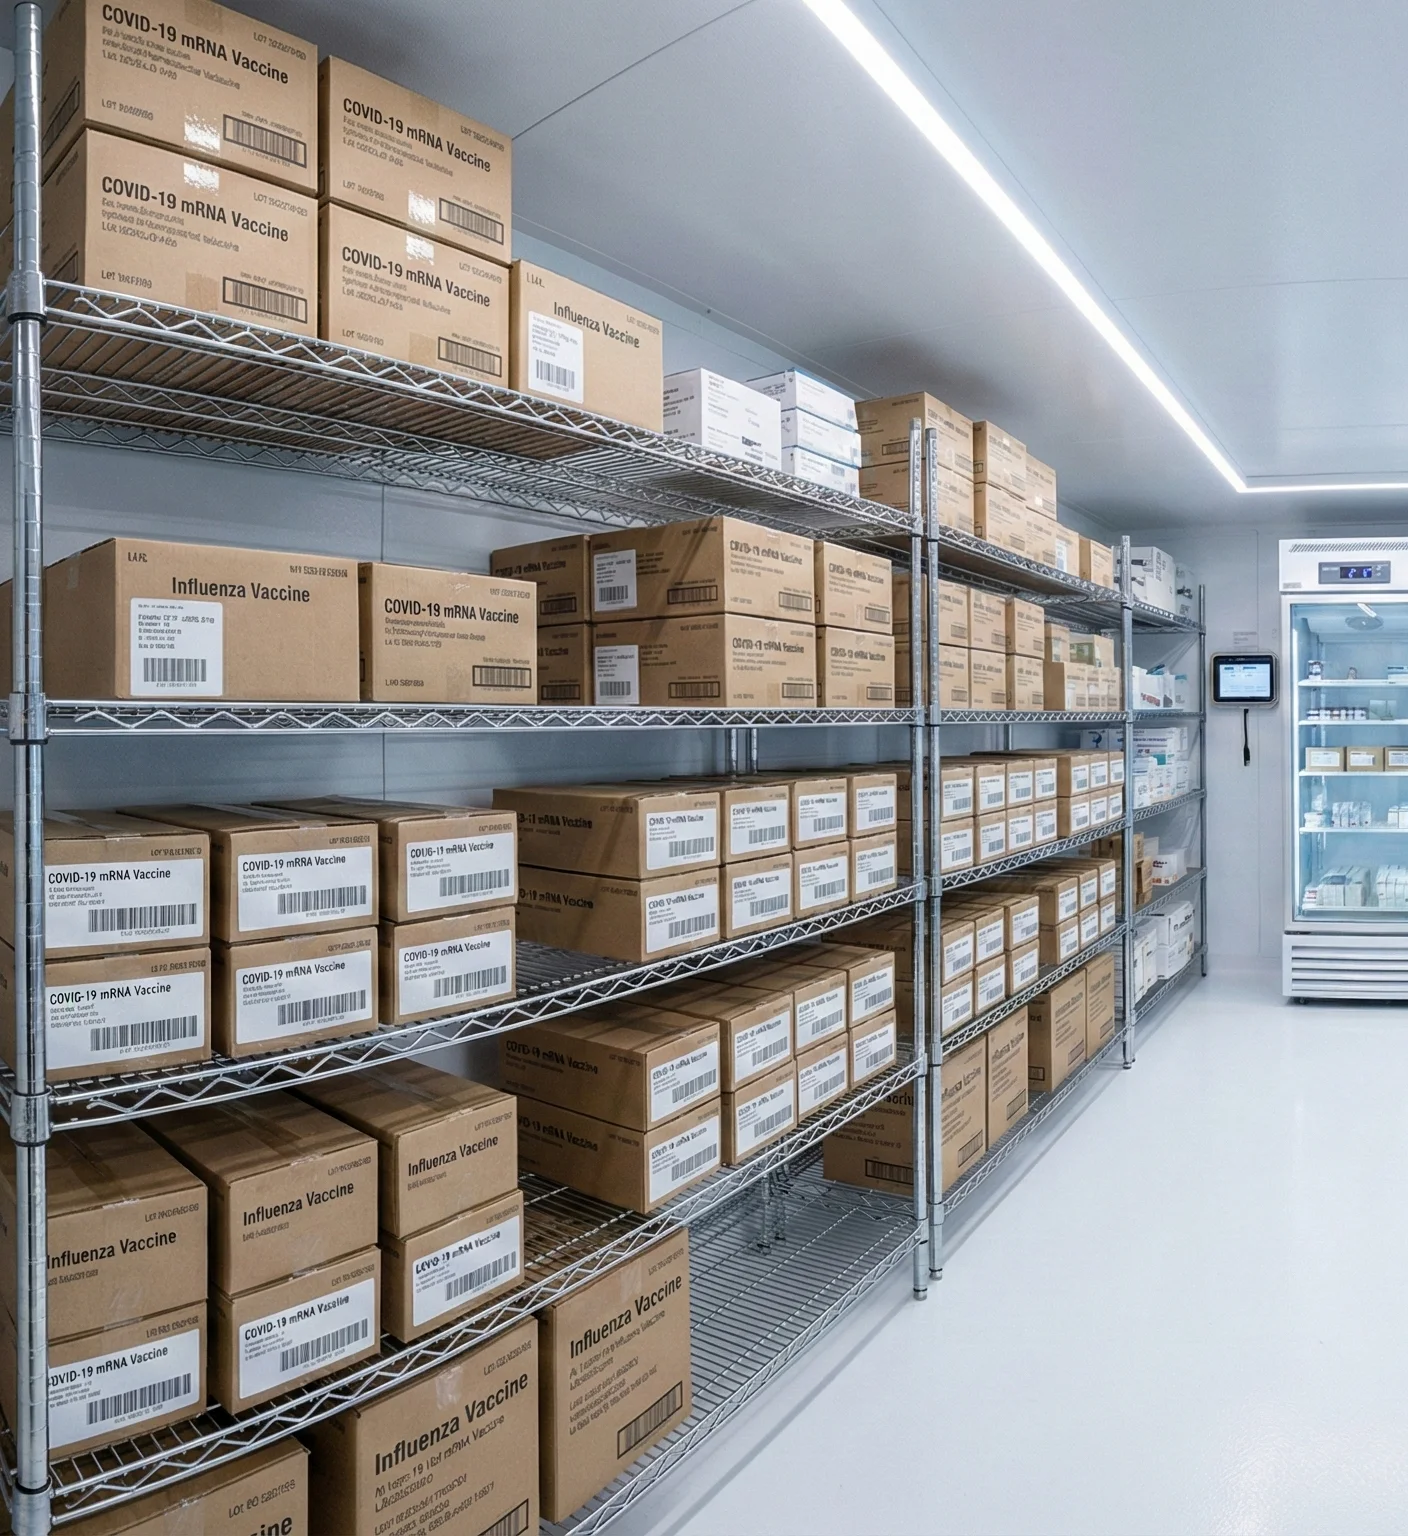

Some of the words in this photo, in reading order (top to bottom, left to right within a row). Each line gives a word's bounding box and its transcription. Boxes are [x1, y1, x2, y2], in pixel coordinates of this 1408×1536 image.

[102, 3, 177, 43] COVID-19
[181, 33, 228, 62] mRNA
[231, 49, 289, 85] Vaccine
[343, 97, 404, 134] COVID-19
[406, 126, 444, 152] mRNA
[101, 175, 177, 210] COVID-19
[181, 199, 227, 225] mRNA
[231, 210, 289, 242] Vaccine
[341, 246, 403, 278] COVID-19
[405, 269, 443, 292] mRNA
[172, 576, 246, 599] Influenza
[250, 582, 310, 603] Vaccine
[443, 604, 477, 621] mRNA
[48, 871, 97, 885] COVID-19
[99, 869, 131, 882] mRNA
[132, 869, 171, 880] Vaccine
[242, 858, 284, 872] COVID-19
[242, 969, 284, 985] COVID-19
[100, 986, 132, 1000] mRNA
[133, 984, 172, 996] Vaccine
[408, 1150, 457, 1177] Influenza
[243, 1198, 303, 1227] Influenza
[46, 1245, 116, 1270] Influenza
[119, 1231, 177, 1255] Vaccine
[570, 1309, 632, 1359] Influenza
[634, 1275, 682, 1316] Vaccine
[95, 1356, 128, 1375] mRNA
[130, 1345, 169, 1365] Vaccine
[375, 1416, 460, 1476] Influenza
[464, 1373, 528, 1424] Vaccine
